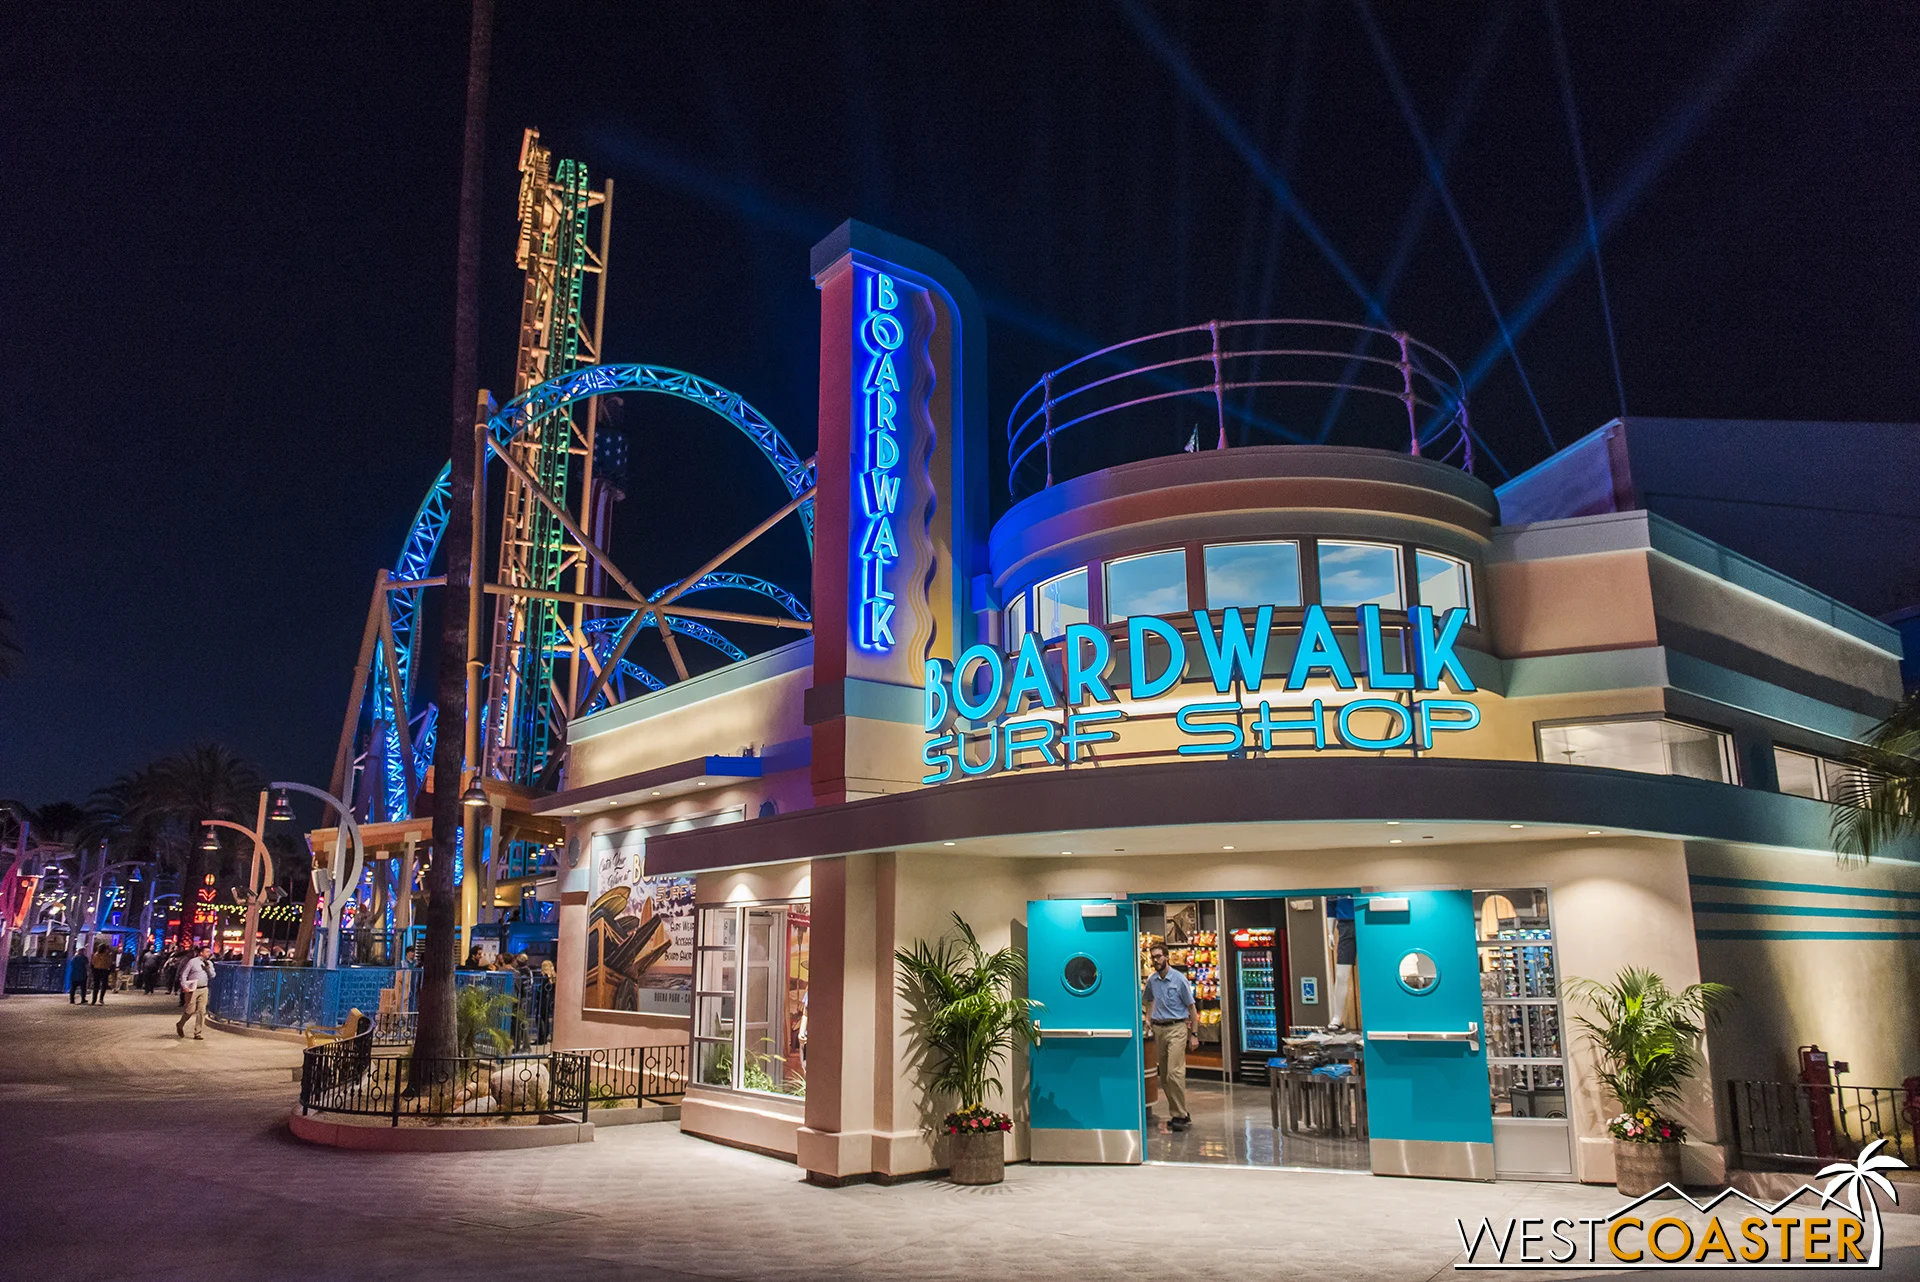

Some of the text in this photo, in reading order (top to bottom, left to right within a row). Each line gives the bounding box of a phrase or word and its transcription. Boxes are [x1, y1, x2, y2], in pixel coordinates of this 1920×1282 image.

[868, 272, 905, 647] BOARDWALK
[924, 603, 1476, 733] BOARDWALK
[922, 698, 1481, 785] SURF SHOP
[656, 884, 688, 902] SURF
